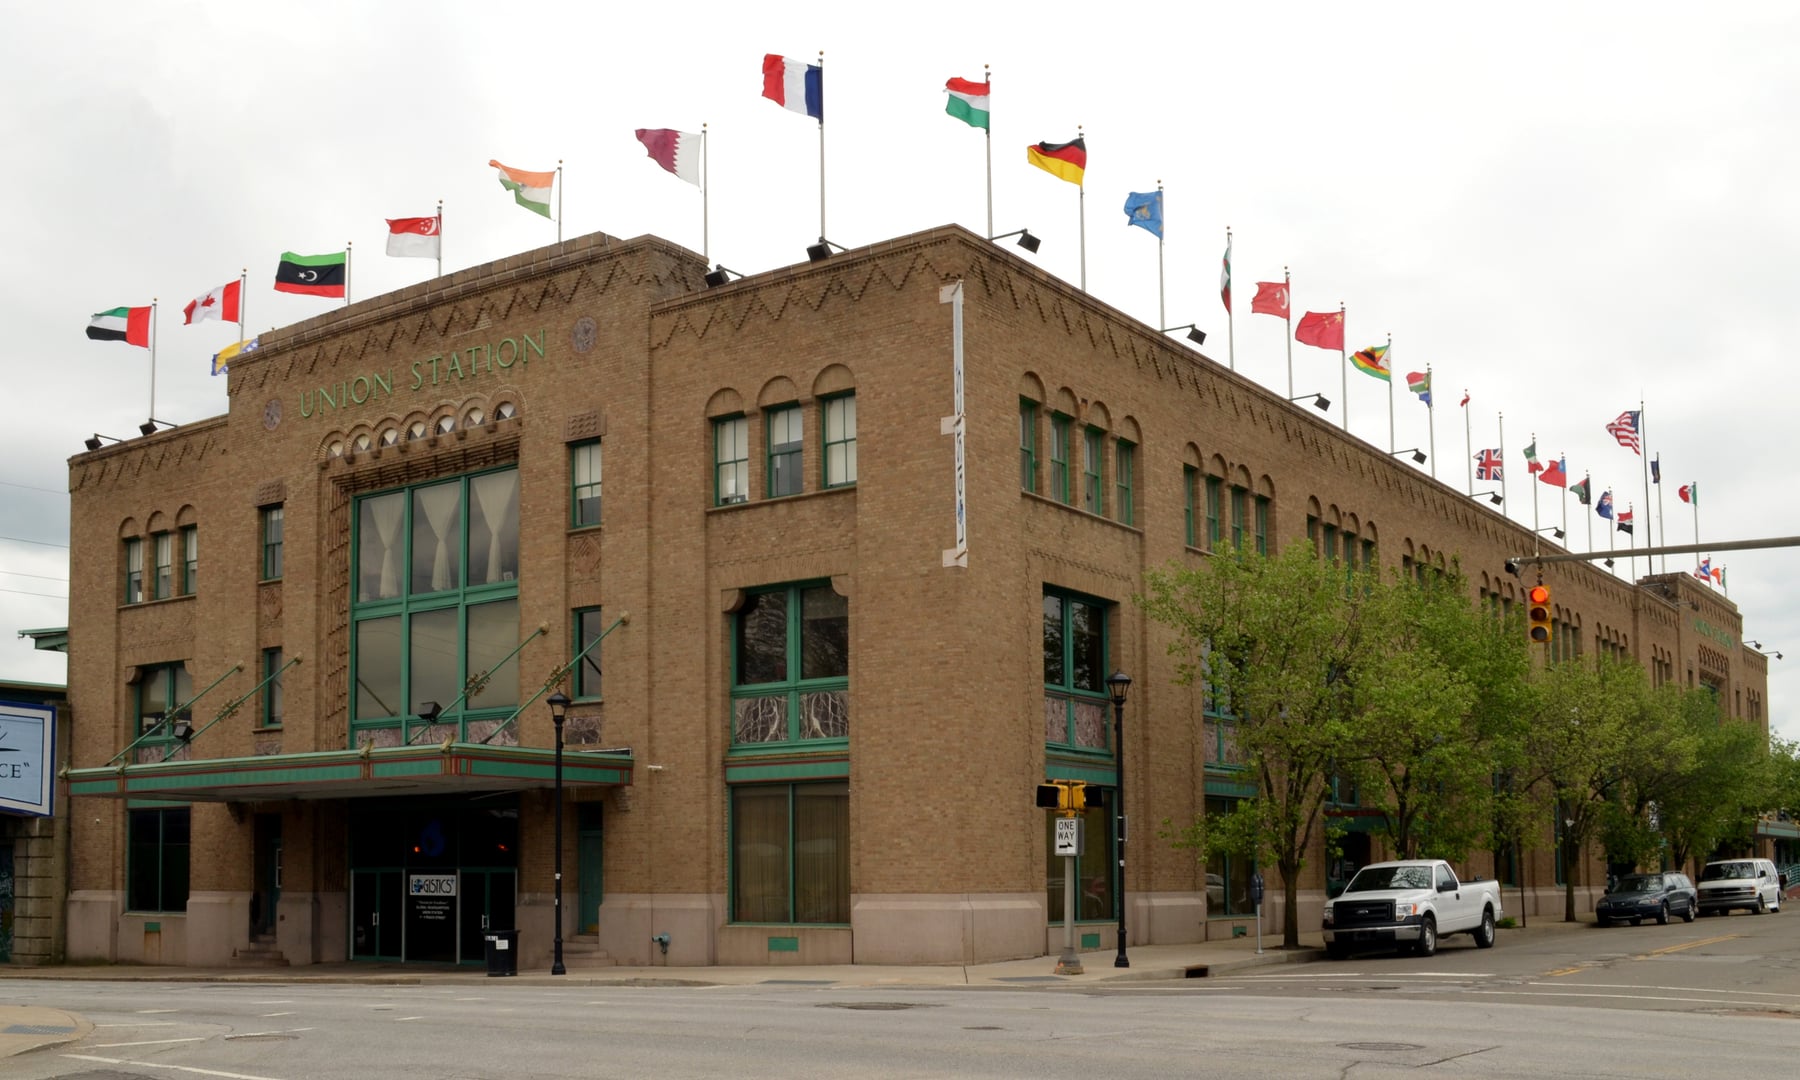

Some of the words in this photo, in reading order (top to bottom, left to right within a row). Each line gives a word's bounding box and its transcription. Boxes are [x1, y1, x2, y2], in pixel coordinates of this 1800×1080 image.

[300, 368, 393, 418] UNION
[410, 329, 546, 390] STATION
[1058, 821, 1075, 831] ONE
[1057, 831, 1075, 841] WAY
